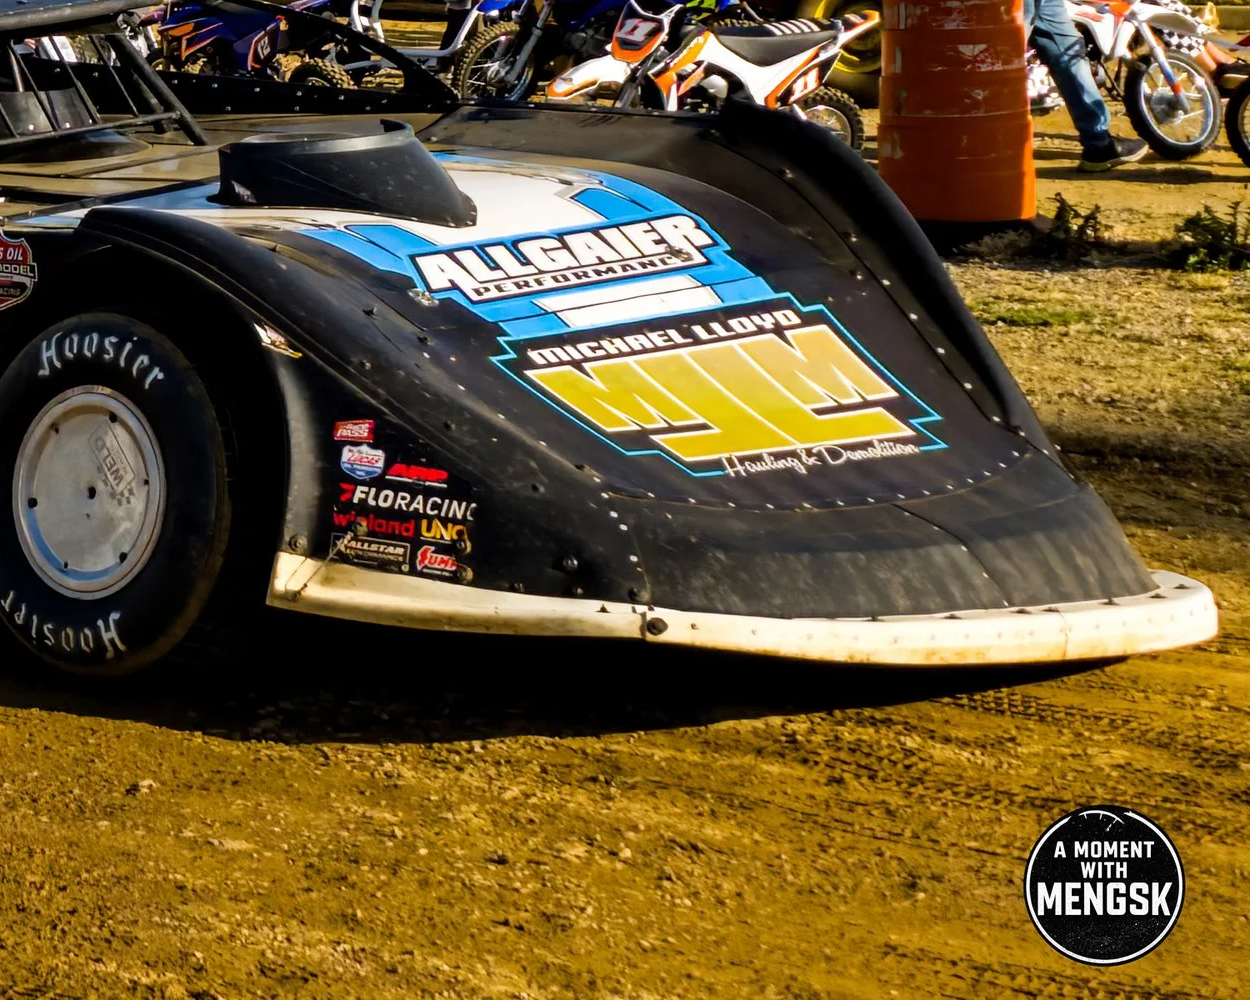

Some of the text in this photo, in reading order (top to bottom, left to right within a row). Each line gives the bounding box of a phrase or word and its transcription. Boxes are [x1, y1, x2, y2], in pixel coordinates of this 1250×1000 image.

[6, 247, 24, 261] OIL
[413, 215, 715, 291] ALLGAIER
[470, 252, 688, 297] PERFORMANC
[37, 330, 165, 389] Hoosier
[527, 309, 802, 364] MICHAEL LLOYD
[720, 452, 807, 479] Hauling
[815, 438, 920, 466] Demolition
[0, 590, 127, 659] Hoosier
